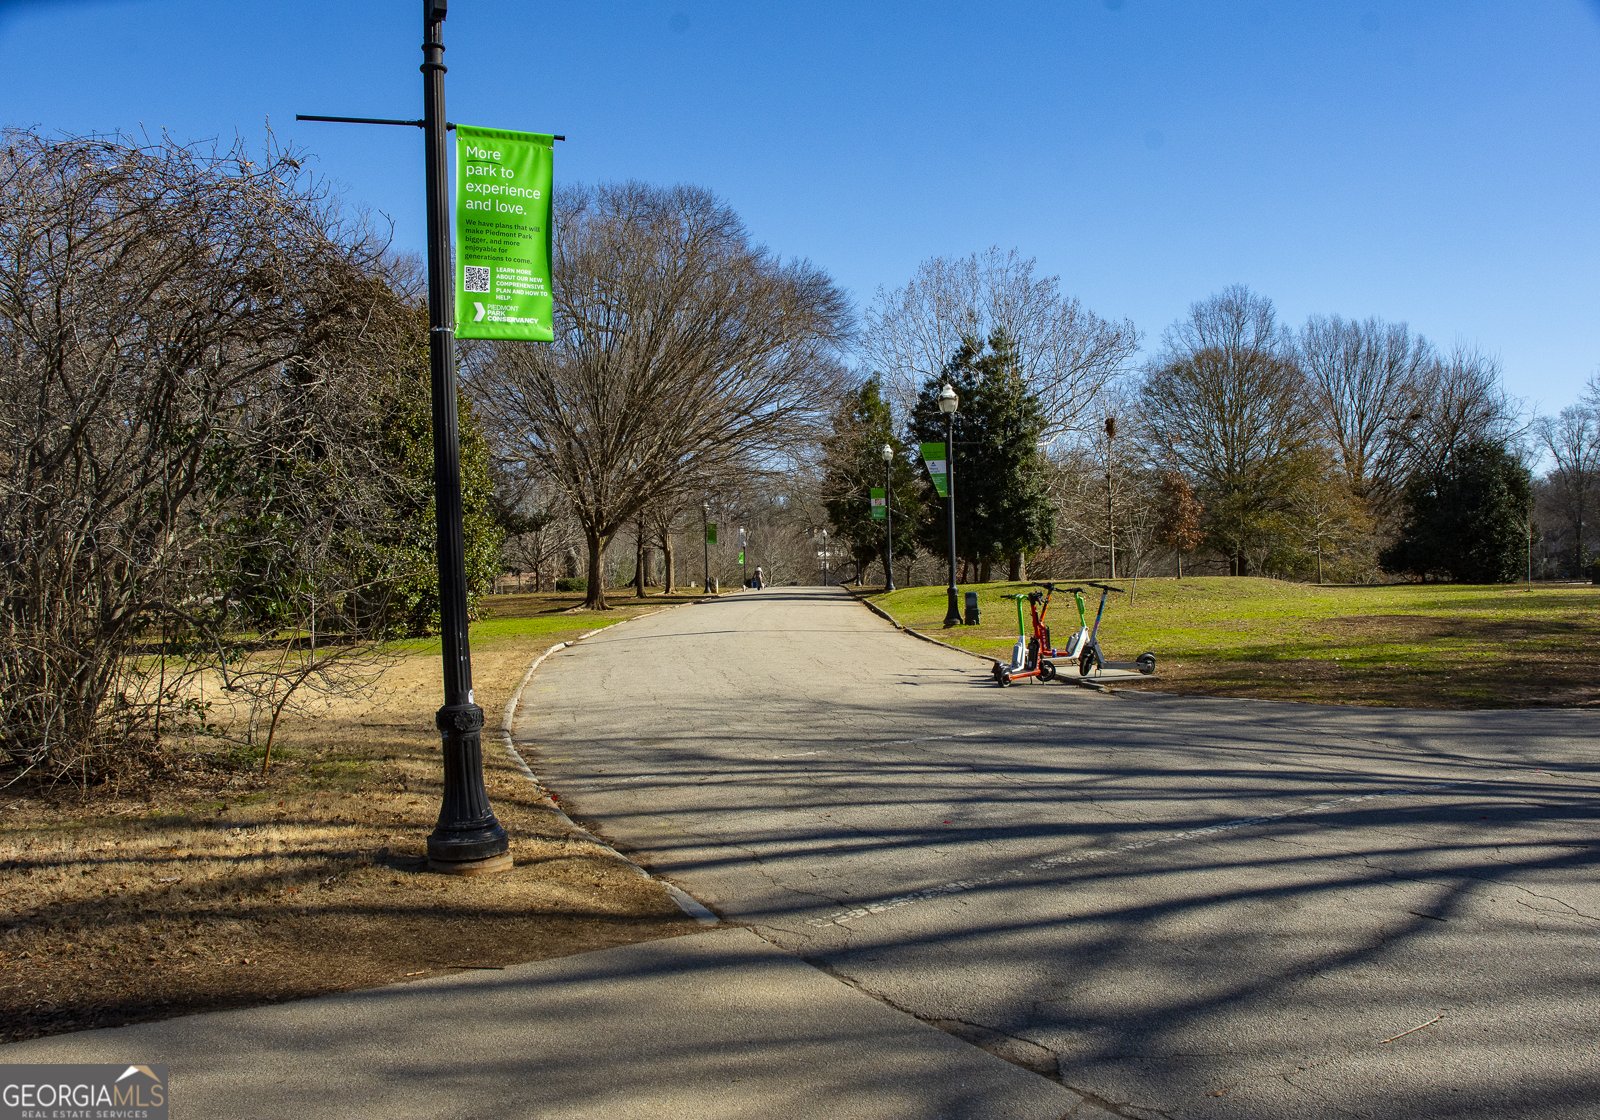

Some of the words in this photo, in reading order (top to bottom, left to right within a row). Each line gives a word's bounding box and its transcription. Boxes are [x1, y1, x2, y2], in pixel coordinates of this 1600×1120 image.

[466, 146, 500, 160] More
[466, 165, 497, 177] park
[501, 167, 514, 179] to
[466, 182, 540, 200] experience
[465, 199, 491, 211] and
[496, 200, 527, 216] love.
[478, 220, 494, 228] have
[495, 221, 513, 230] plans
[514, 223, 528, 231] that
[529, 225, 541, 233] will
[465, 236, 489, 244] bigger,
[485, 230, 517, 238] Piedmont
[518, 232, 533, 240] Park
[464, 245, 498, 253] enjoyable
[498, 246, 508, 254] for
[496, 281, 544, 290] COMPREHENSIVE
[487, 316, 538, 324] CONSERVANCY
